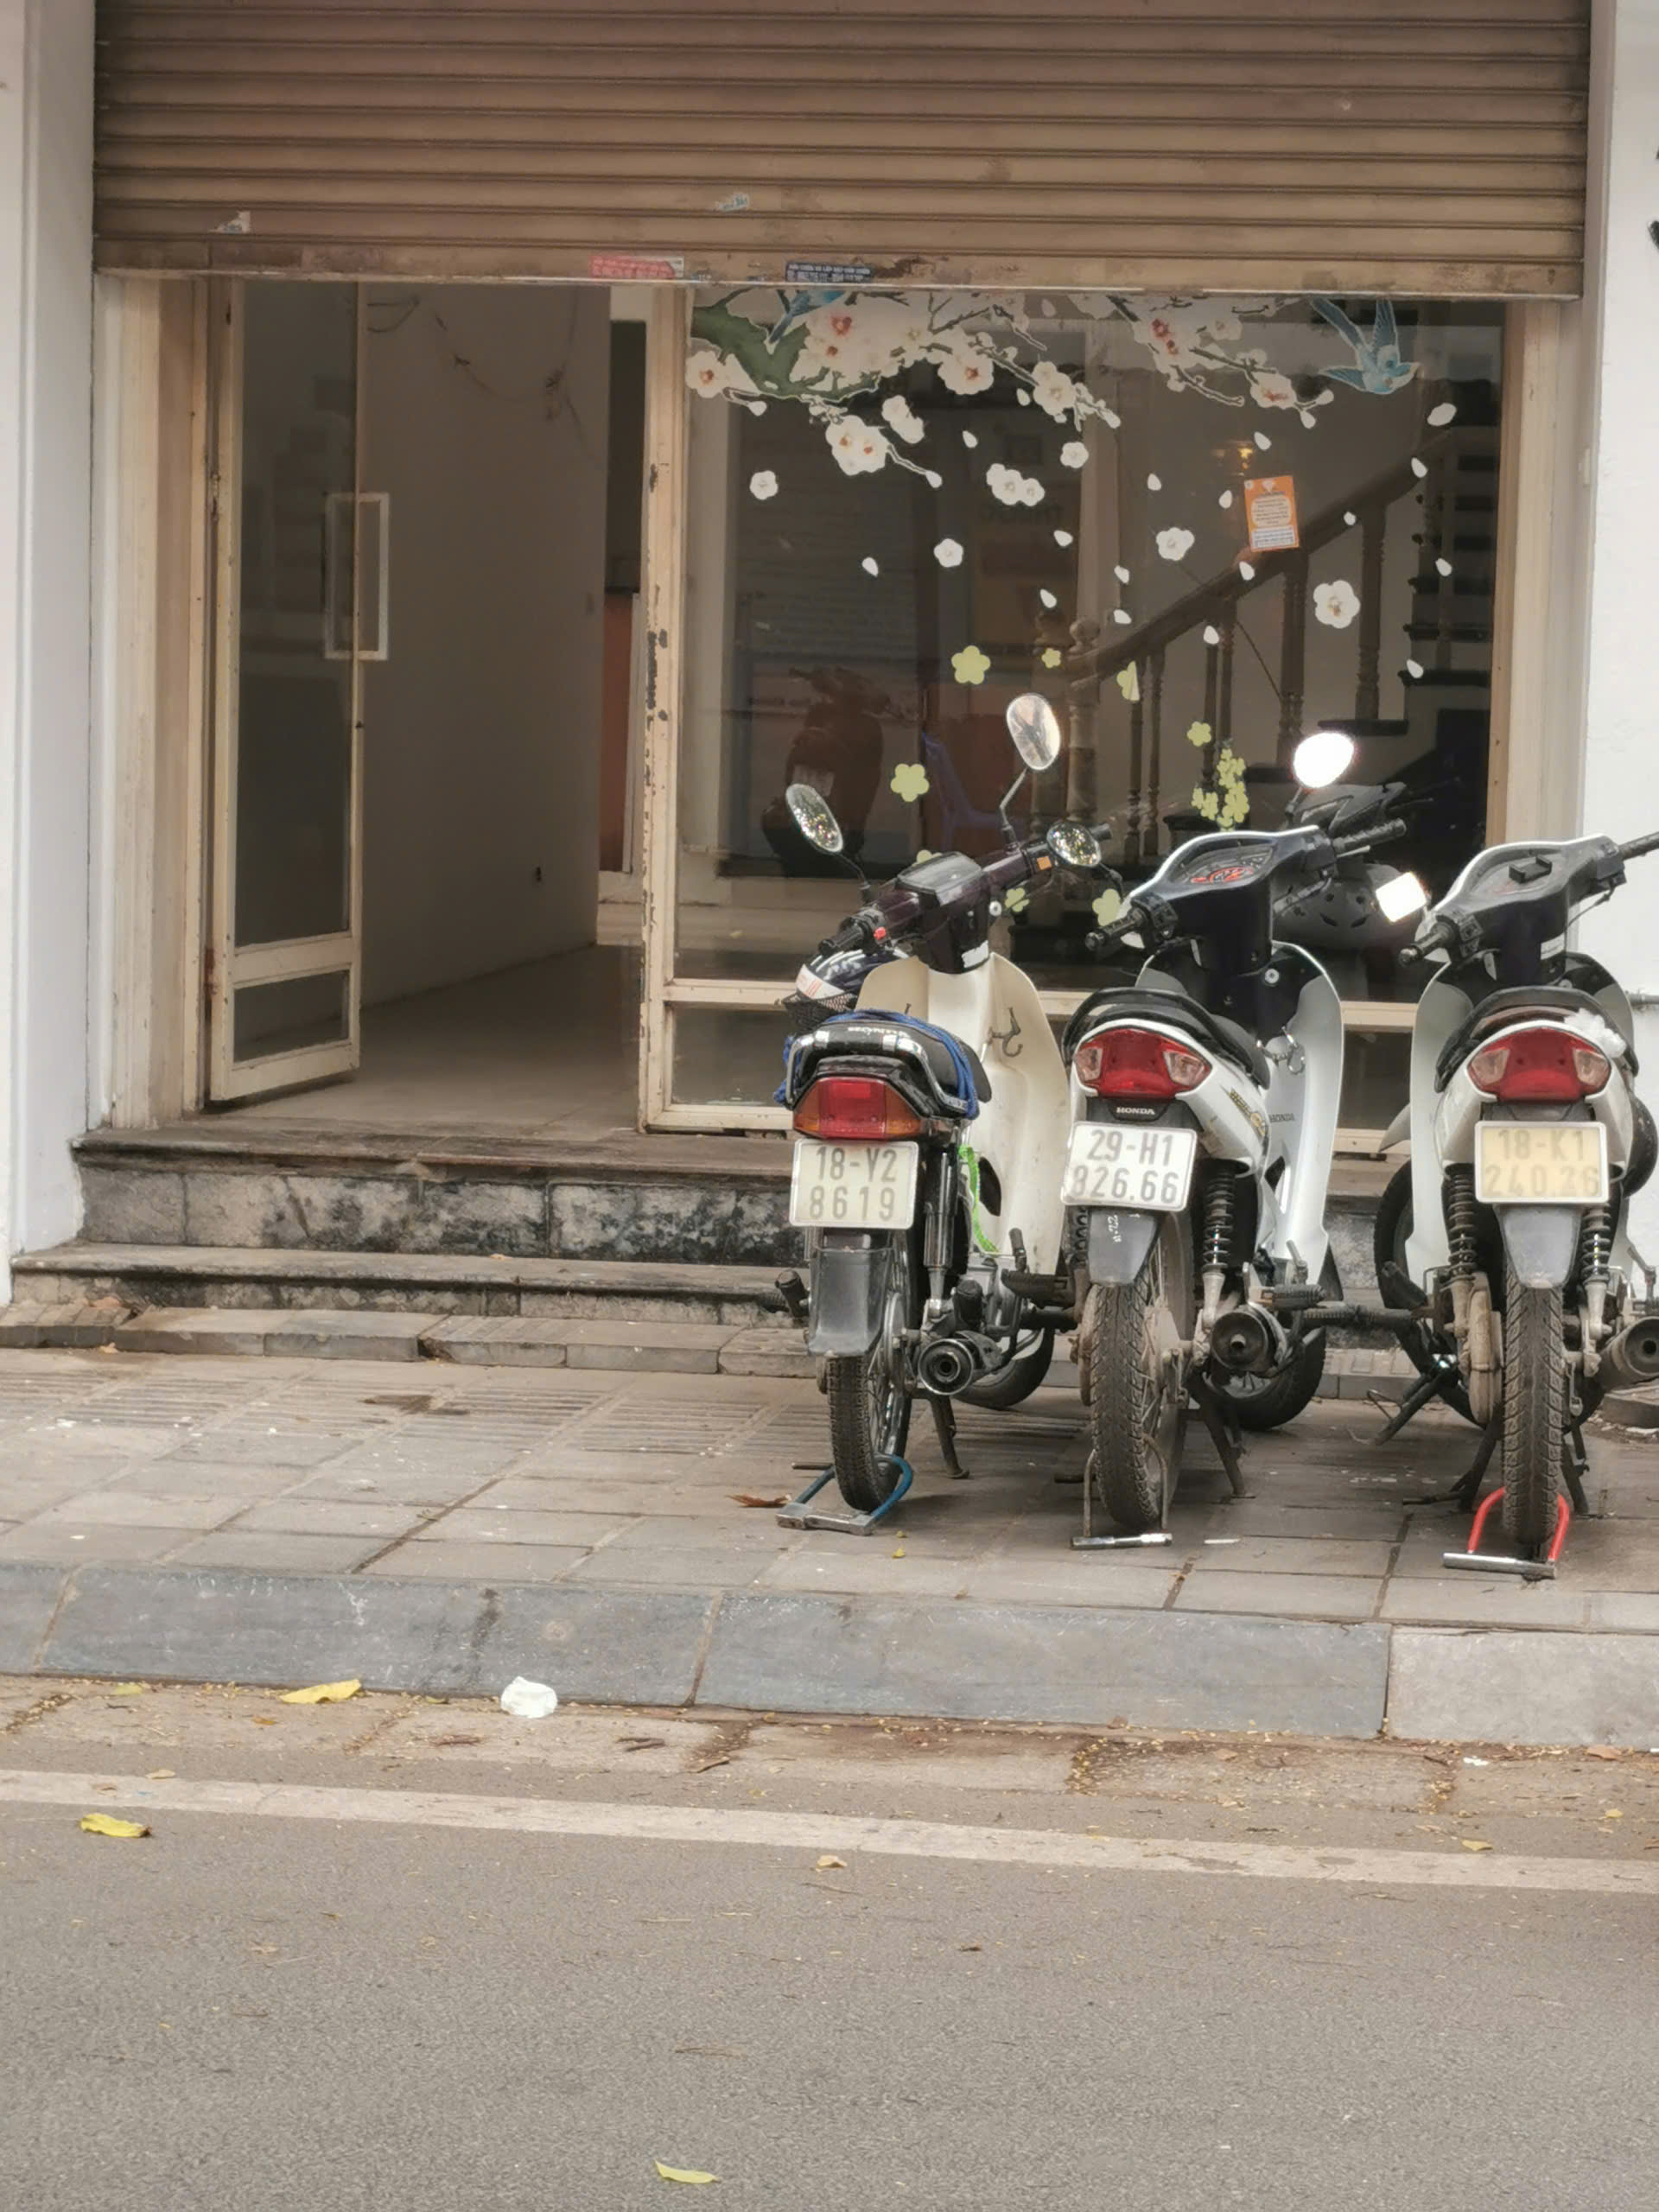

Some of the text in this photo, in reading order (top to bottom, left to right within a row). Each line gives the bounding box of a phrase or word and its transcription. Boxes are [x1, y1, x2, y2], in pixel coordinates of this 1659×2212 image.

[1116, 1106, 1155, 1116] HONDA
[1089, 1128, 1173, 1166] 29-H1
[1497, 1128, 1584, 1161] 18-K1
[815, 1146, 898, 1183] 18-Y2
[809, 1185, 895, 1222] 8619
[1073, 1166, 1179, 1205] 826.66
